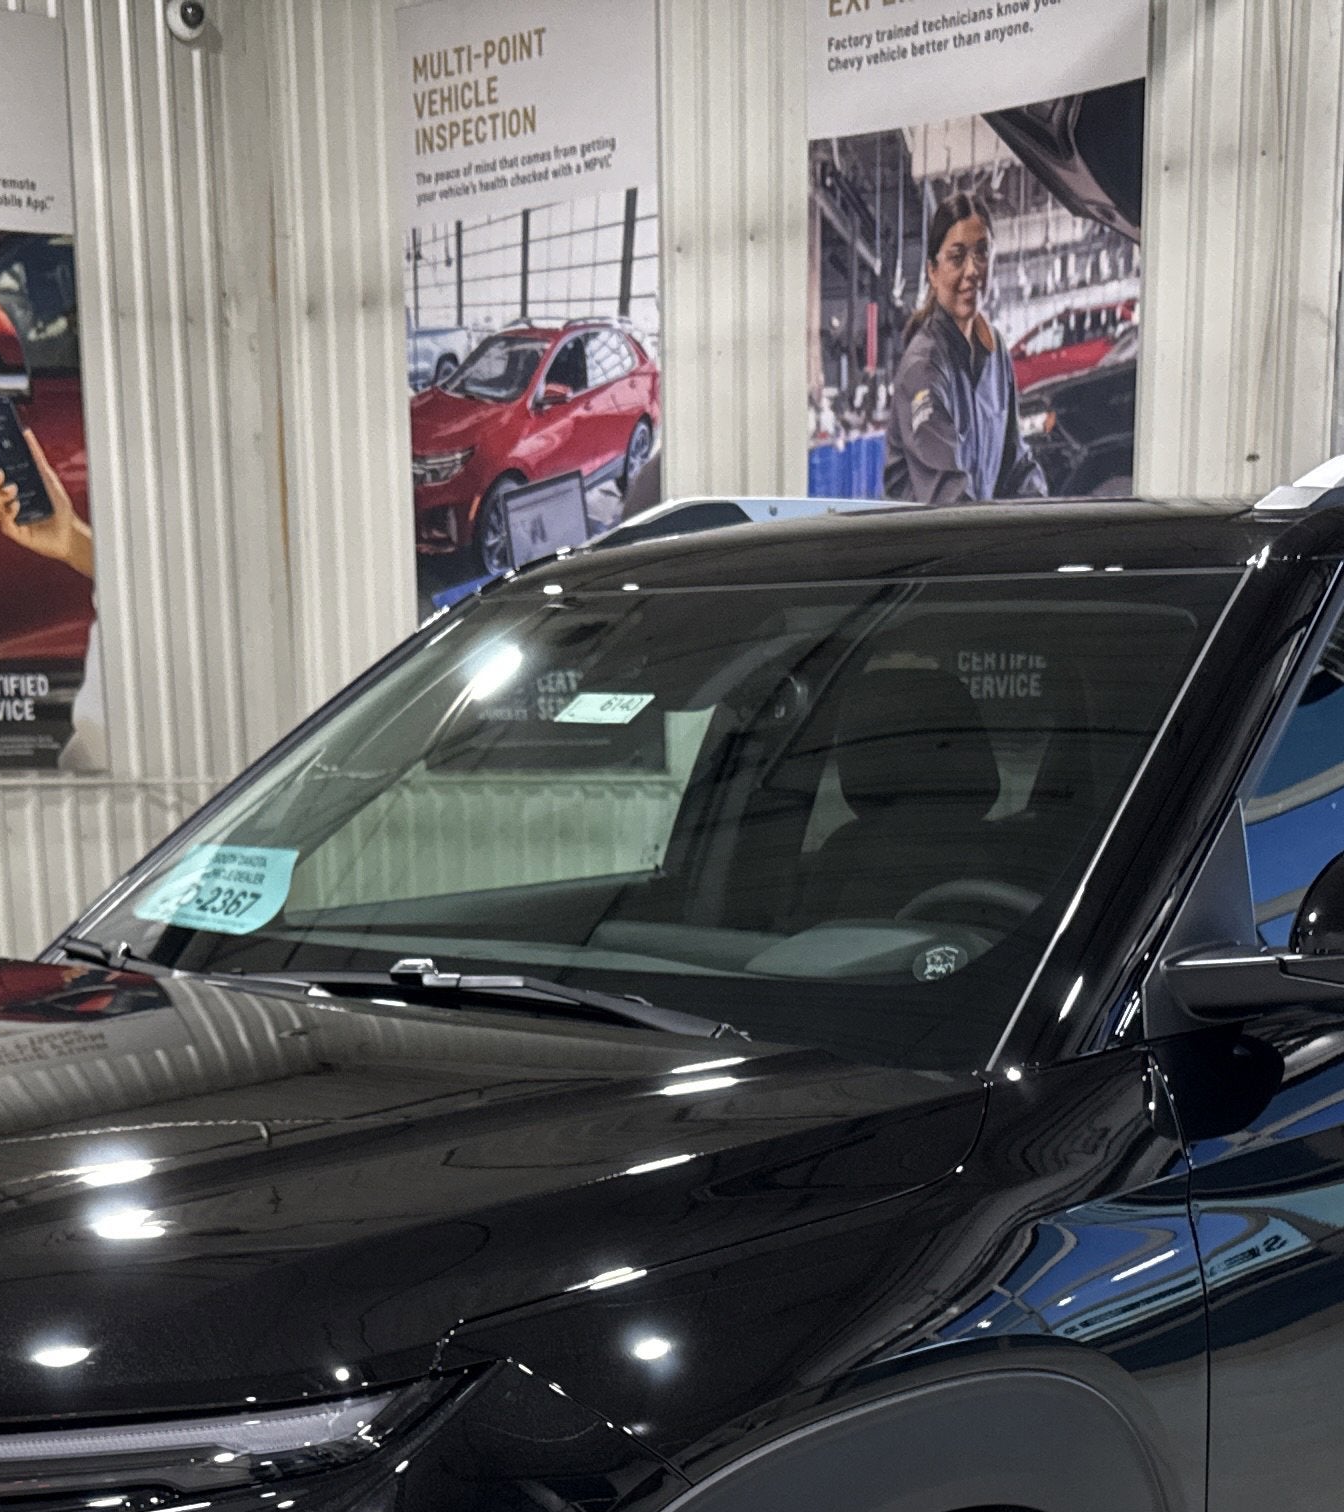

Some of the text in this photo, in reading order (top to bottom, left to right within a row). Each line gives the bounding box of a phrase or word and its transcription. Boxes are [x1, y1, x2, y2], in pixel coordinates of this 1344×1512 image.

[827, 33, 872, 52] Factory
[876, 20, 919, 42] trained
[922, 8, 993, 34] technicians
[997, 0, 1030, 17] know
[827, 21, 1033, 72] Chevy vehicle better than anyone.
[413, 27, 547, 84] MULTI-POINT
[413, 75, 499, 119] VEHICLE
[415, 104, 537, 156] INSPECTION
[416, 136, 616, 185] The peace of mind that comes from getting
[416, 191, 436, 207] your
[478, 175, 508, 192] health
[510, 167, 549, 187] checked
[551, 162, 573, 179] with
[576, 163, 582, 174] a
[957, 649, 1047, 672] CERTIFIE
